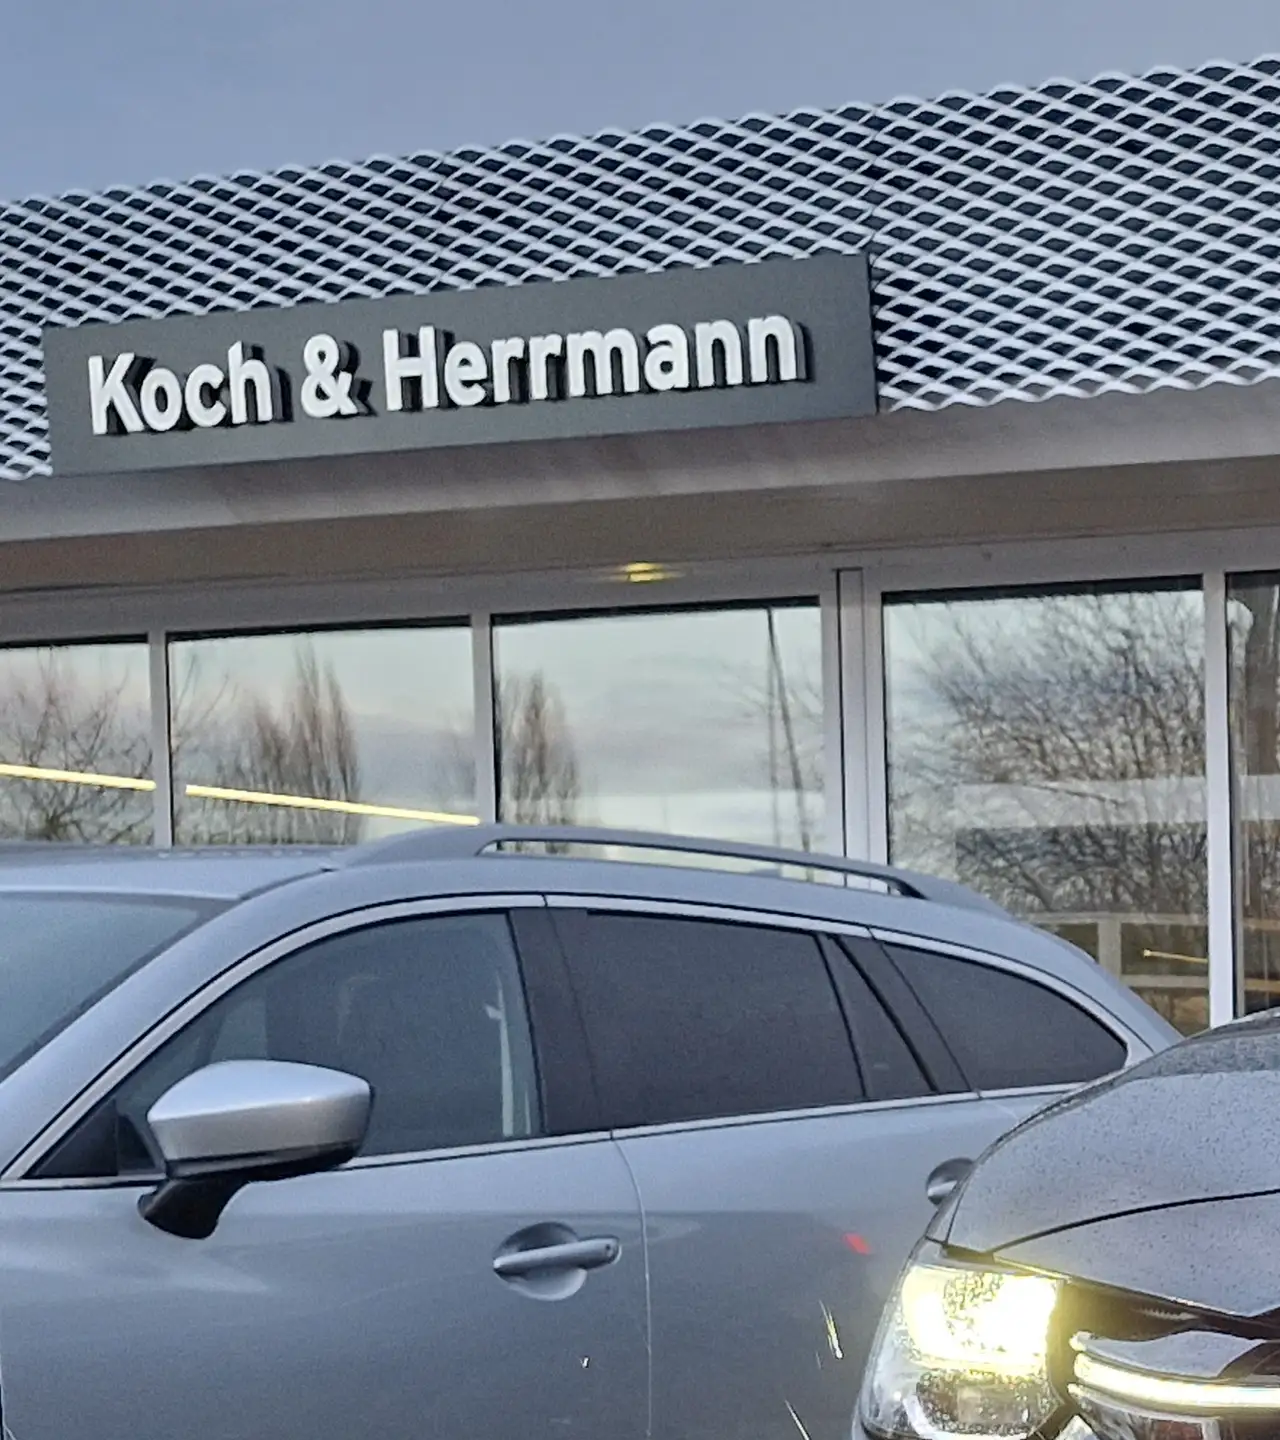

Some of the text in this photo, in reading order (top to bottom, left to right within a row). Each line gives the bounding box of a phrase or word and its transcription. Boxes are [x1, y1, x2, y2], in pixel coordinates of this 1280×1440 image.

[88, 312, 799, 436] Koch & Herrmann
